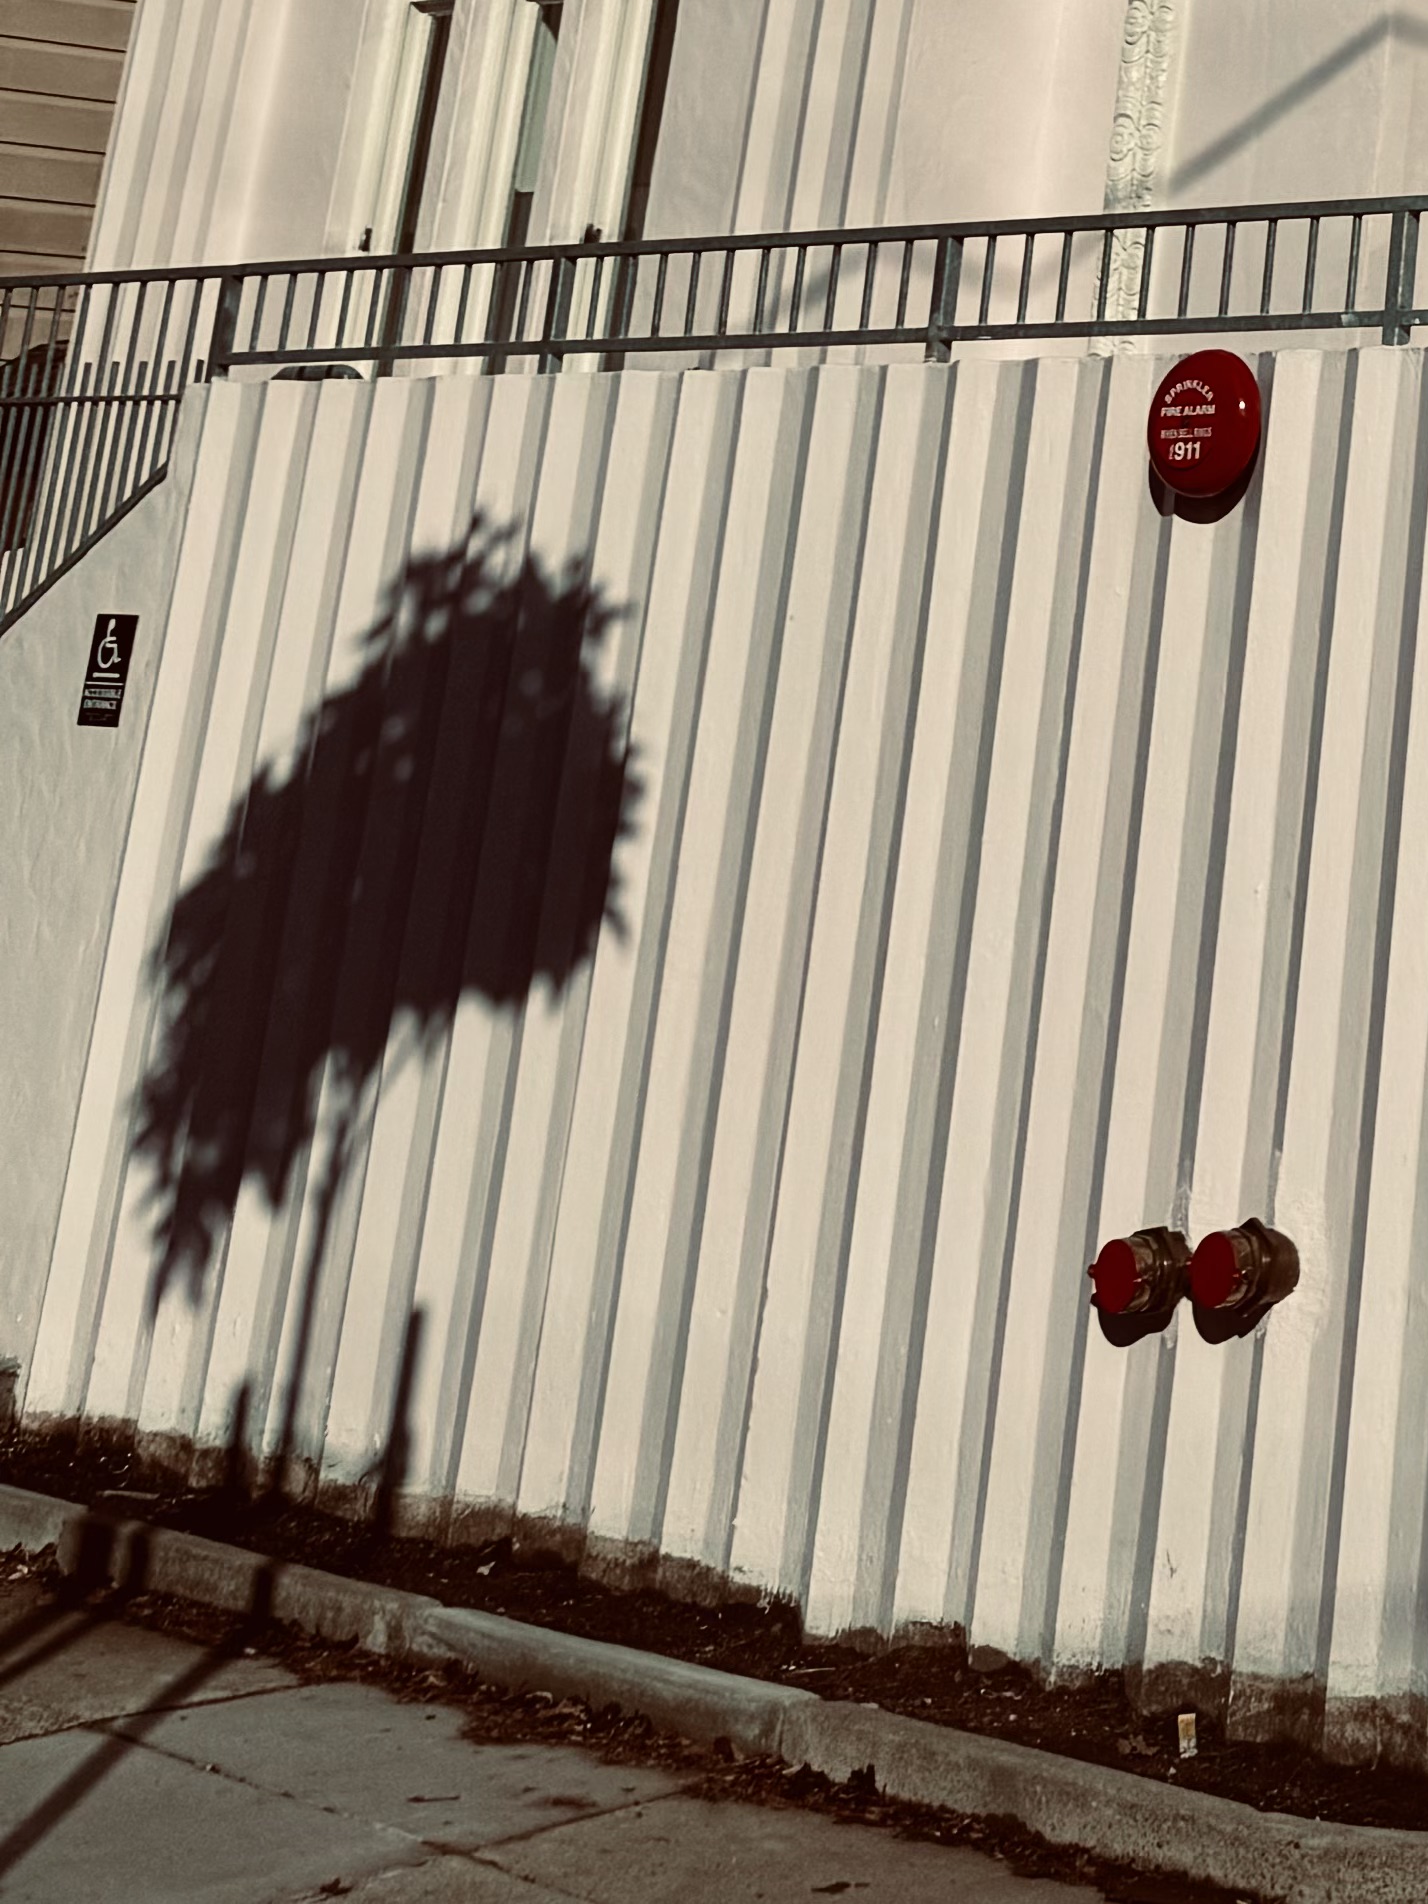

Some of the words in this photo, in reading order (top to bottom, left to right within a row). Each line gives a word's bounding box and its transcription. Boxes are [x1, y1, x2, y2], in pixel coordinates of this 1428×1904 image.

[1160, 406, 1182, 417] FIRE
[1182, 404, 1216, 416] ALARM
[1174, 441, 1201, 461] 911
